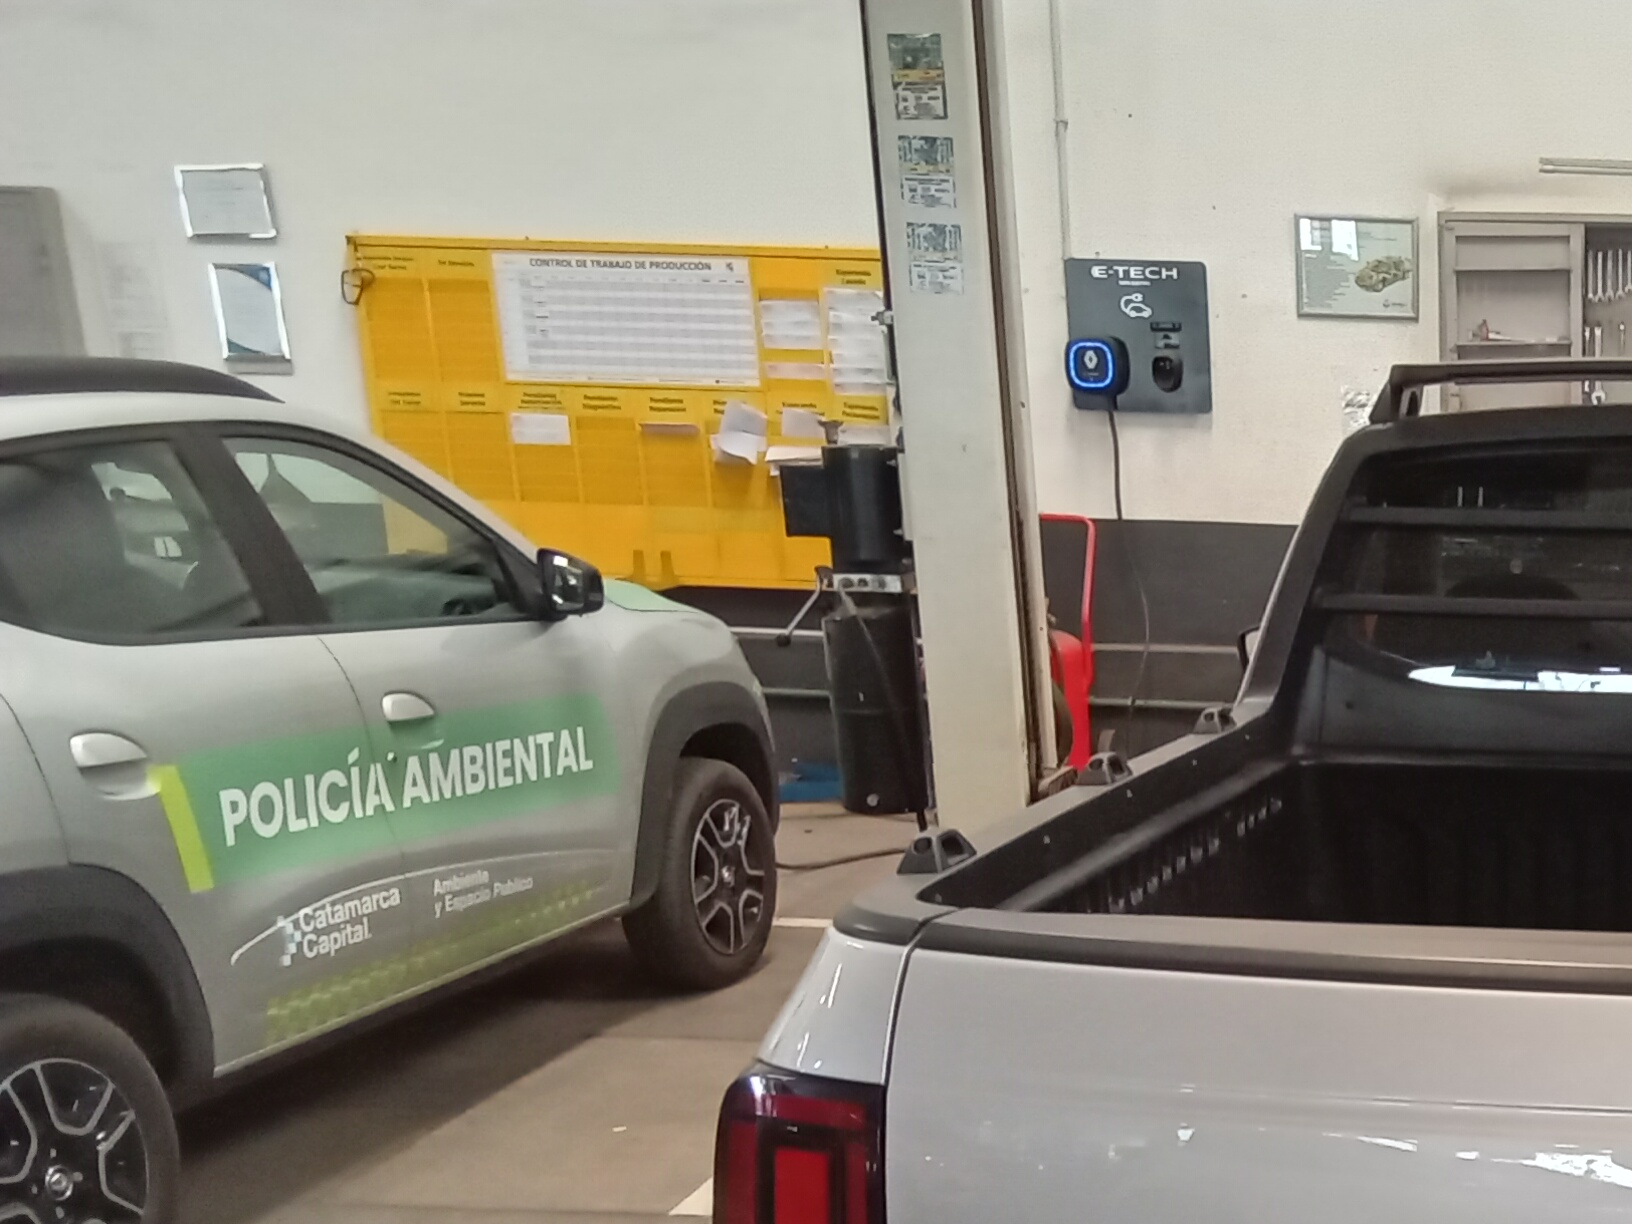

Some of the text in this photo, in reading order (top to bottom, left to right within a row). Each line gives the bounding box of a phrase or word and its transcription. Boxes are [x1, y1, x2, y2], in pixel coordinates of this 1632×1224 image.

[529, 258, 573, 268] CONTROL
[575, 259, 588, 268] DE
[590, 260, 632, 269] TRABAJO
[634, 261, 647, 269] DE
[1090, 265, 1178, 280] E-TECH
[219, 726, 593, 847] POLICÍA AMBIENTAL
[433, 870, 489, 896] Ambiente
[299, 887, 401, 932] Catamarca
[445, 889, 491, 911] Espacio
